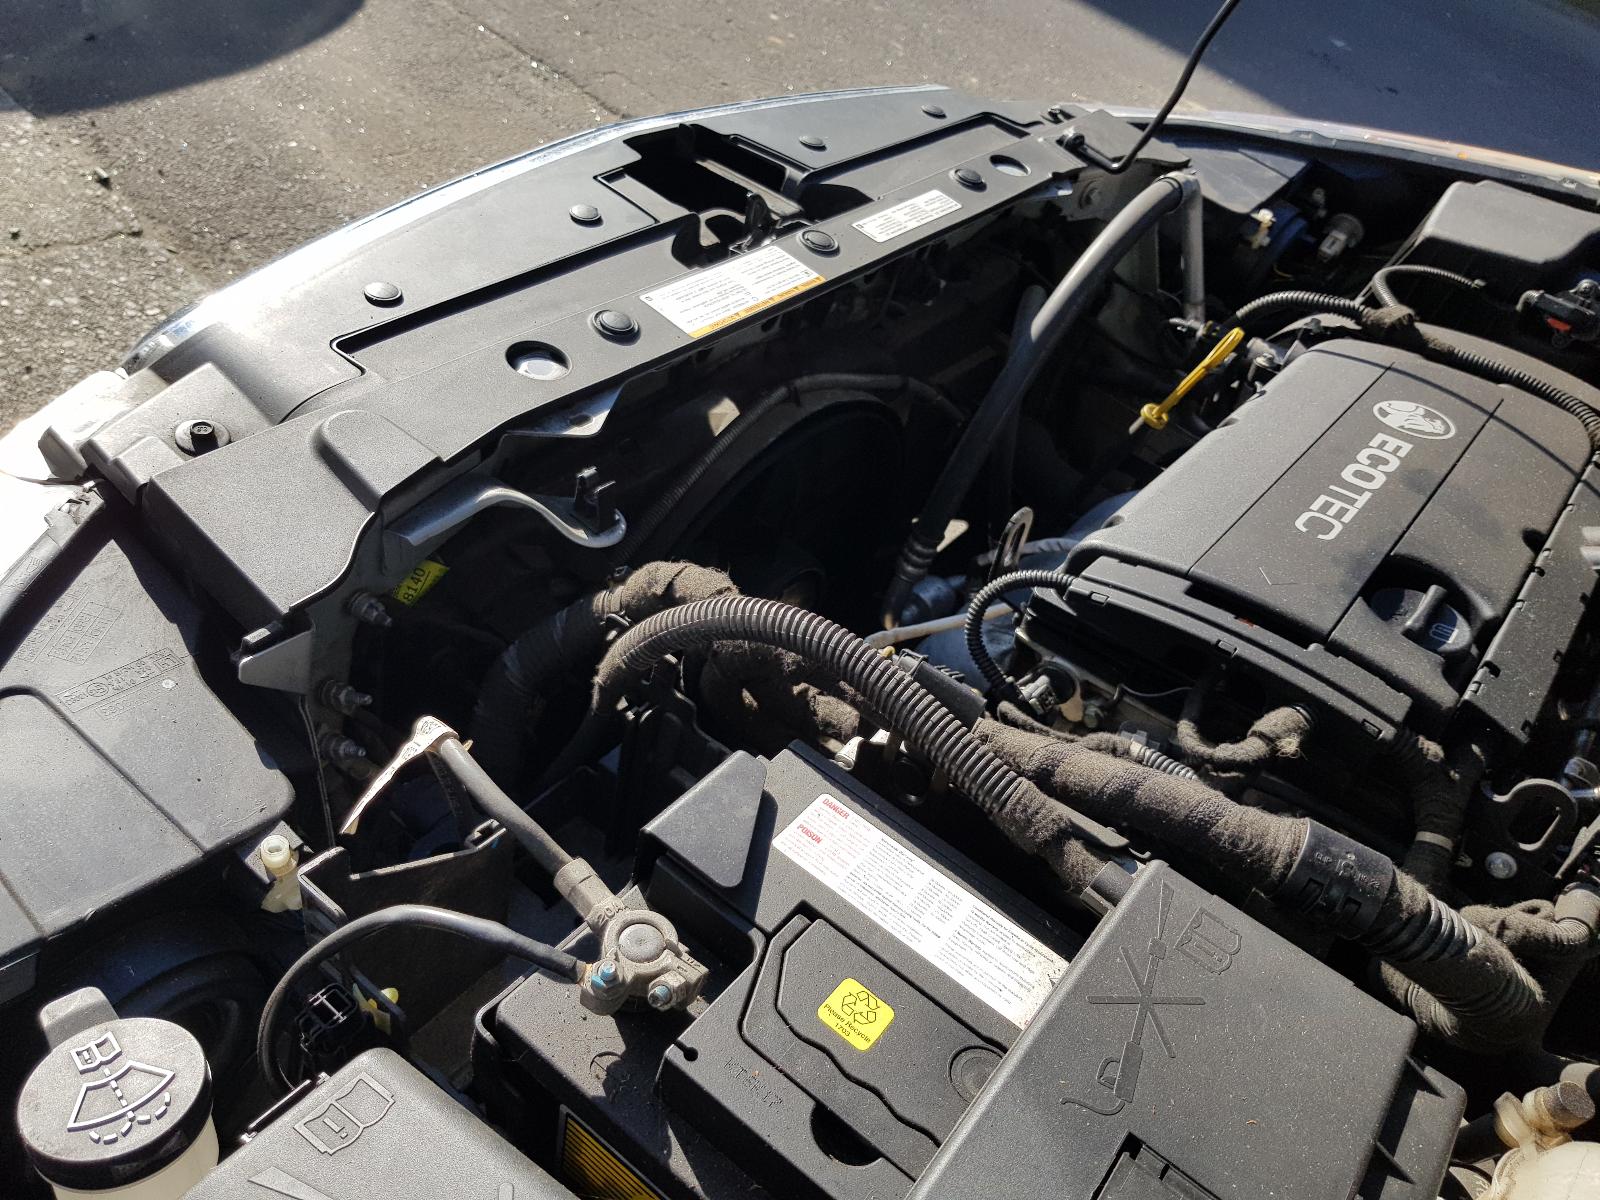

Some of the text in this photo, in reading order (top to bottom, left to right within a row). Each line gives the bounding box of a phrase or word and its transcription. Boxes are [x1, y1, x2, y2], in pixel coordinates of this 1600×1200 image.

[1294, 432, 1414, 541] ECOTEC
[402, 567, 426, 602] 8140
[822, 798, 850, 821] DANGER
[796, 823, 822, 845] POISON
[823, 1003, 871, 1043] Please Recycle
[835, 1022, 851, 1037] 1703
